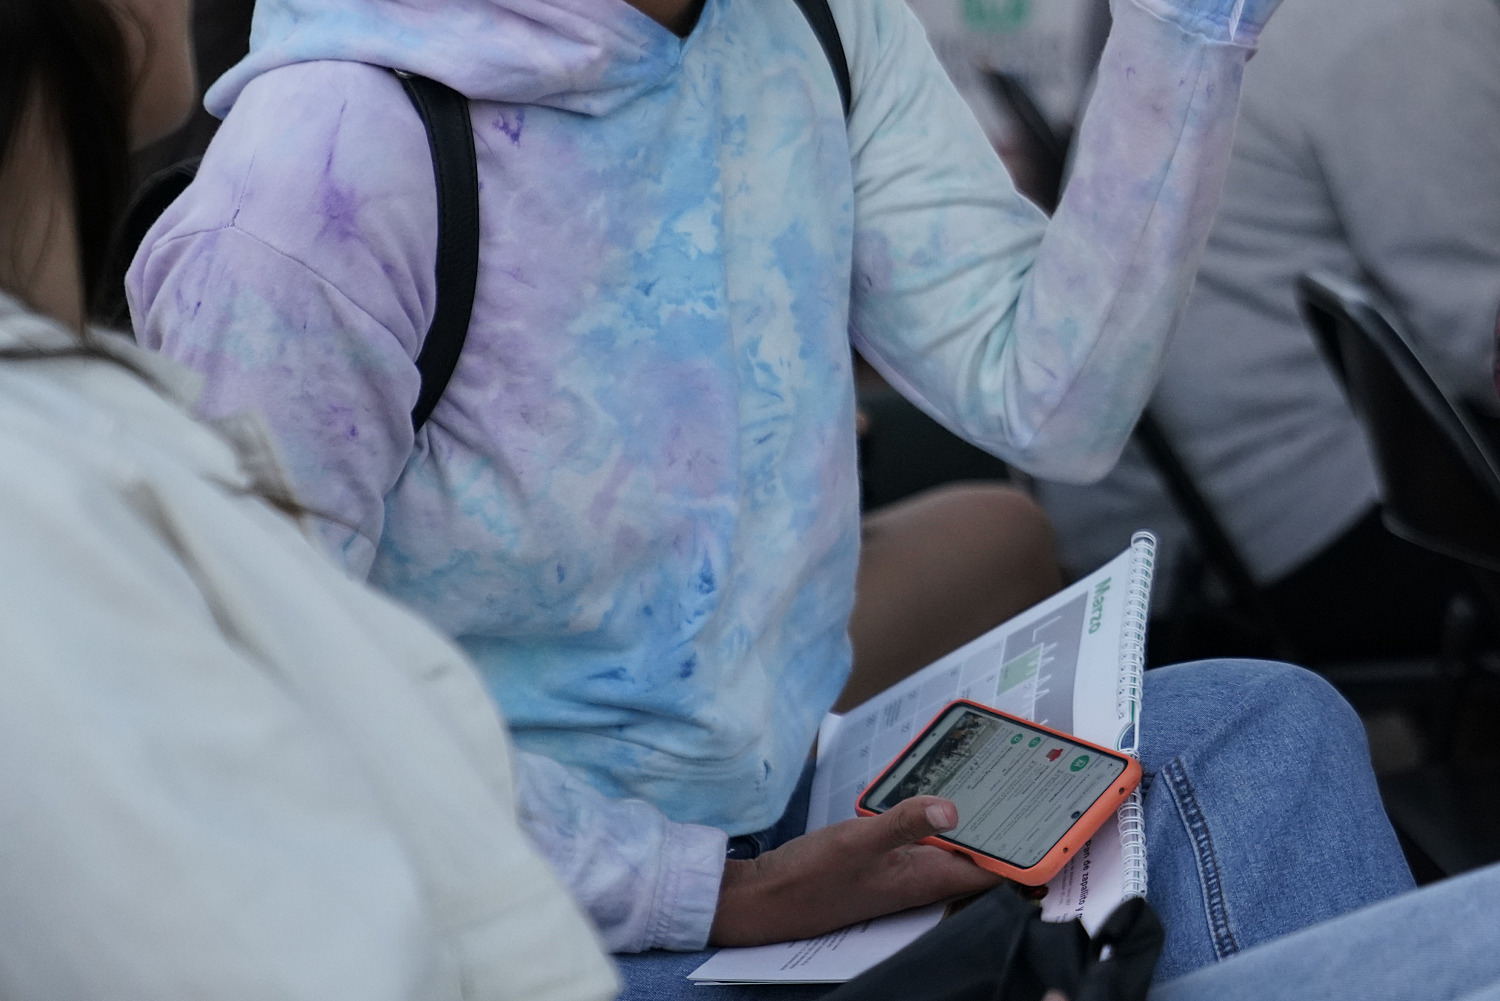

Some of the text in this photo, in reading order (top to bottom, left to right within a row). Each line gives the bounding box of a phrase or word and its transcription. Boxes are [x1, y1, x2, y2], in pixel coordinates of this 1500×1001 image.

[1088, 577, 1112, 634] Marzo
[1083, 860, 1091, 871] de
[1079, 872, 1088, 905] zapallito
